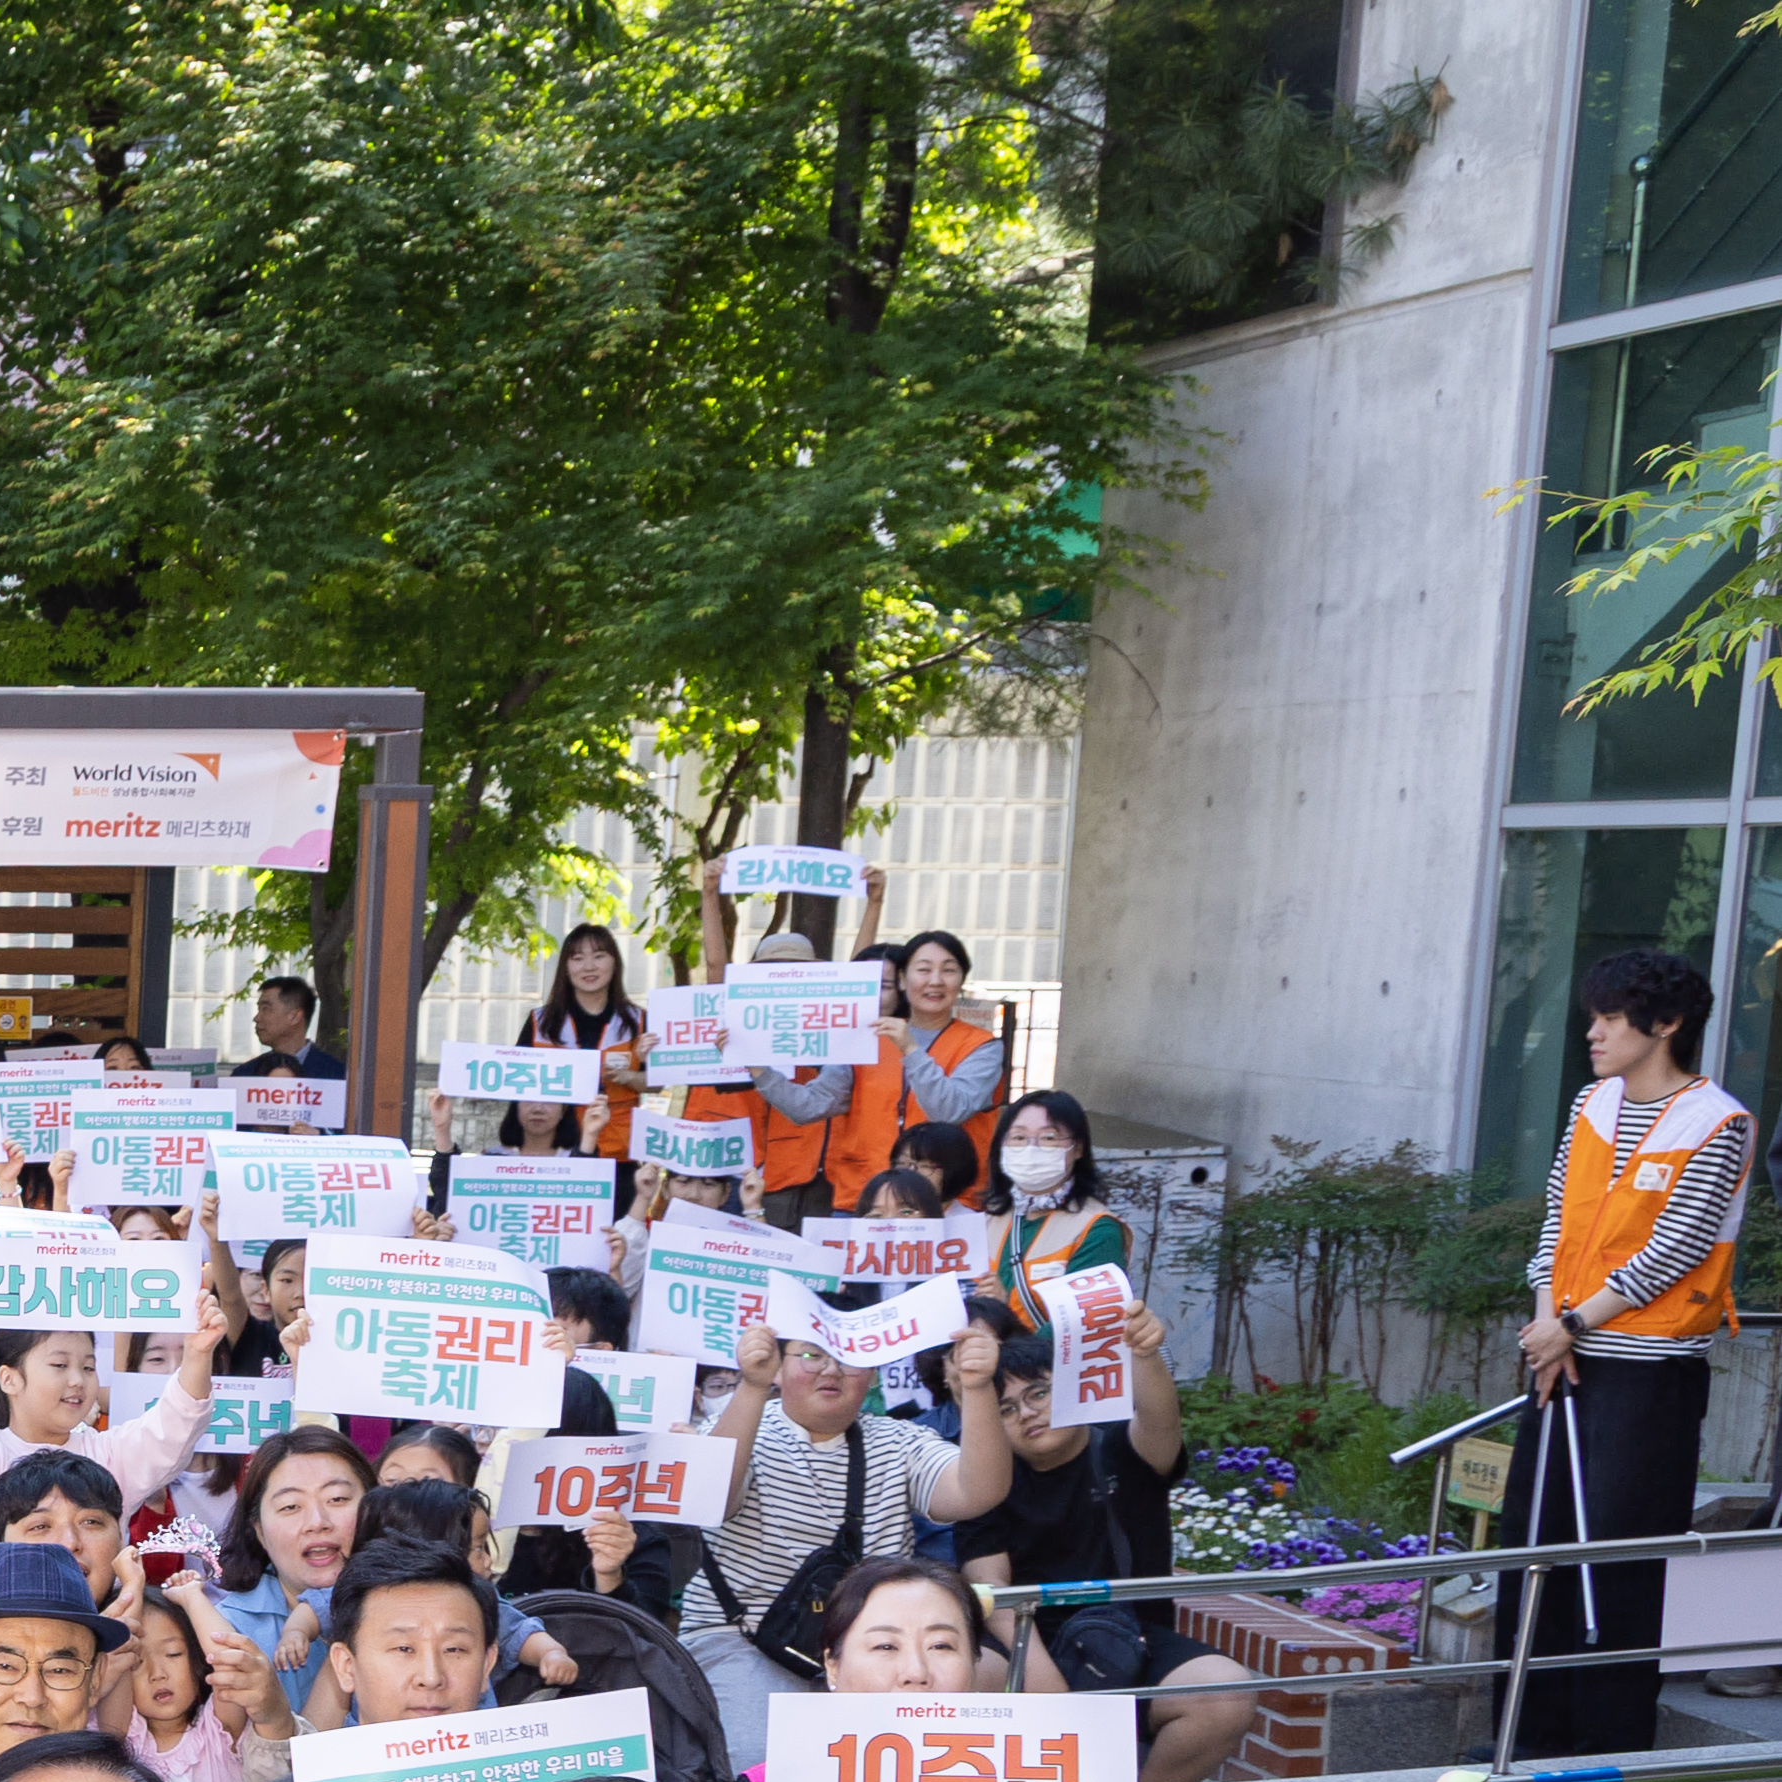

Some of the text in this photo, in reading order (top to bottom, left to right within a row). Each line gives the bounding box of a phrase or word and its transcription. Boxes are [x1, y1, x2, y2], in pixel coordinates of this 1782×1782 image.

[5, 766, 47, 786] 주최
[73, 764, 197, 782] World Vision
[1, 812, 251, 838] 후원 meritz 메리츠화재
[736, 859, 853, 890] 감사해요
[743, 1002, 859, 1030] 아동권리
[772, 1030, 829, 1059] 축제
[465, 1059, 573, 1097] 10주년
[645, 1126, 746, 1167] 감사해요
[37, 1243, 77, 1256] meritz
[335, 1307, 532, 1366] 아동권리
[1067, 1271, 1125, 1403] 감사해요
[381, 1359, 479, 1411] 축제
[534, 1461, 687, 1517] 10주년
[896, 1702, 956, 1719] meritz
